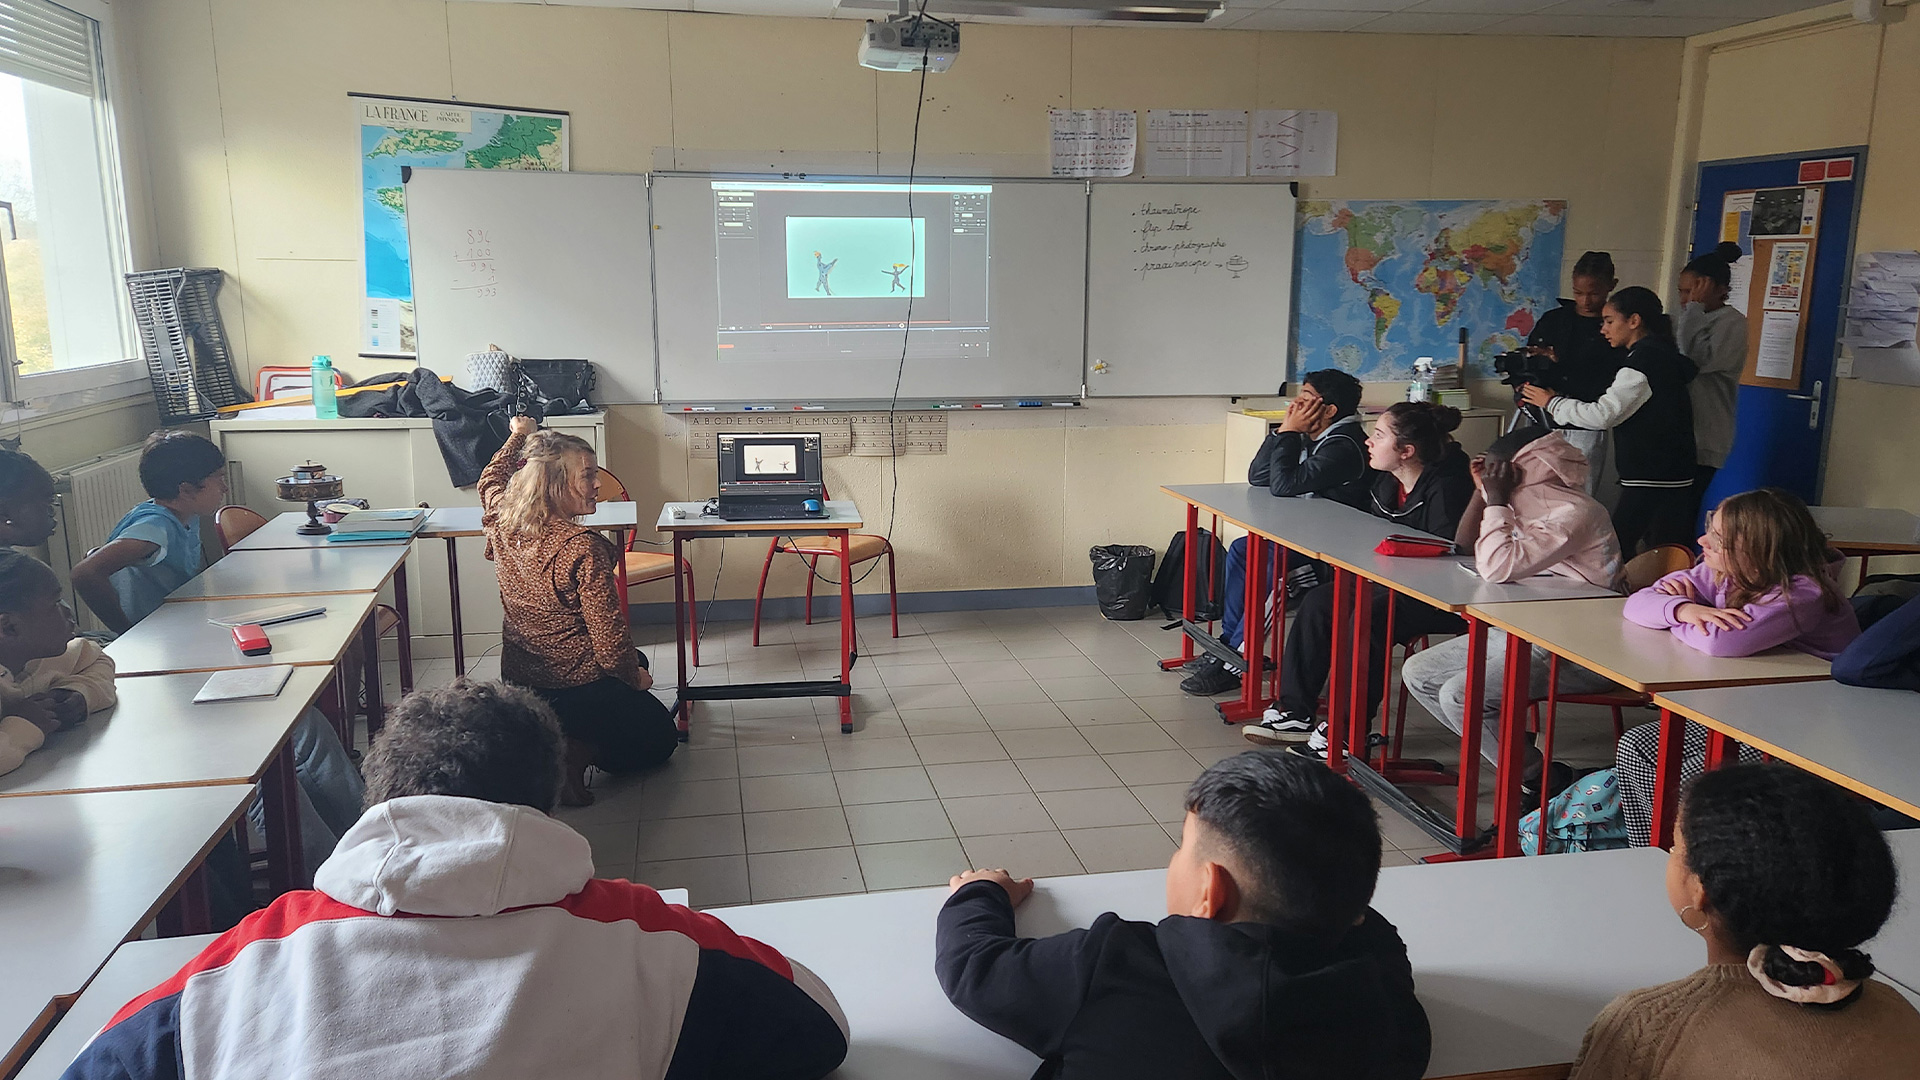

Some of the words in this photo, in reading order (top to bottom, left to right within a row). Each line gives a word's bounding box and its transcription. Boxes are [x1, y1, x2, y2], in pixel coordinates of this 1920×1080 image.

[366, 106, 381, 119] LA
[383, 106, 428, 122] FRANCE
[1140, 202, 1200, 220] thaumatrope
[1141, 220, 1162, 241] flip
[1167, 220, 1193, 231] book
